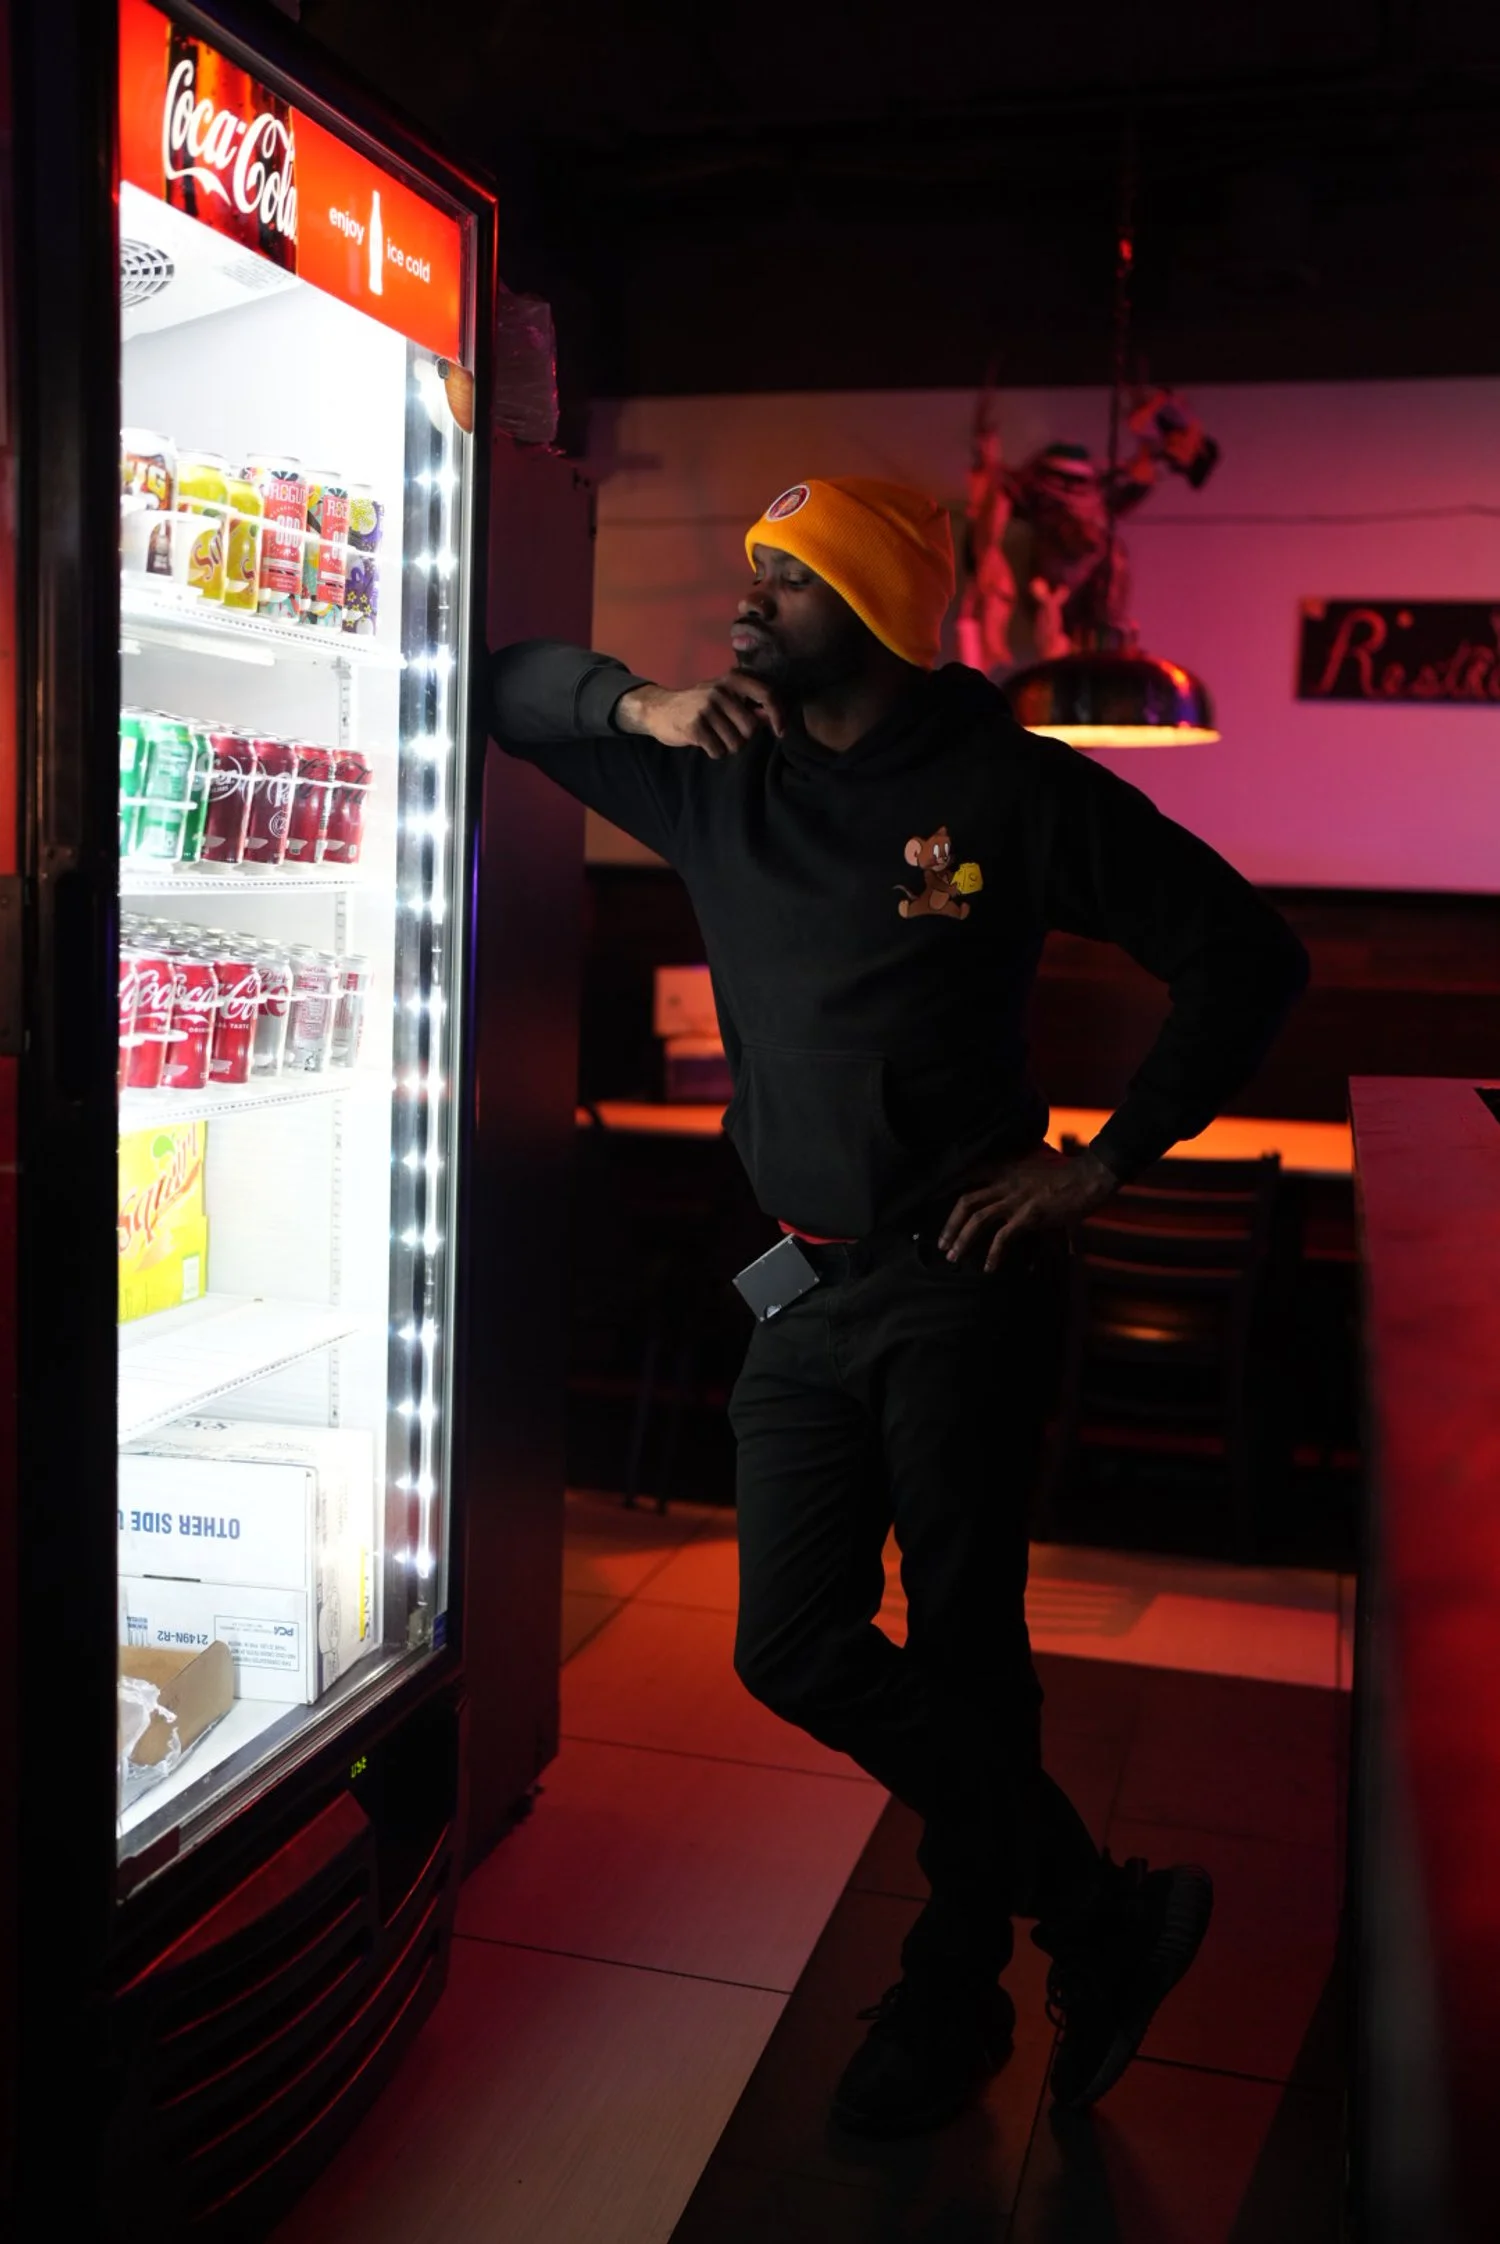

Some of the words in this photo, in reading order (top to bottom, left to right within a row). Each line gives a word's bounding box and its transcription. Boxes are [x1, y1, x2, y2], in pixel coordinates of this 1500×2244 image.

[162, 59, 298, 245] Coca-Cola
[328, 206, 365, 245] enjoy
[386, 237, 404, 268] ice
[405, 254, 431, 284] cold
[131, 1510, 173, 1535] SIDE
[178, 1514, 242, 1540] OTHER
[156, 1628, 209, 1646] 2149N-R2
